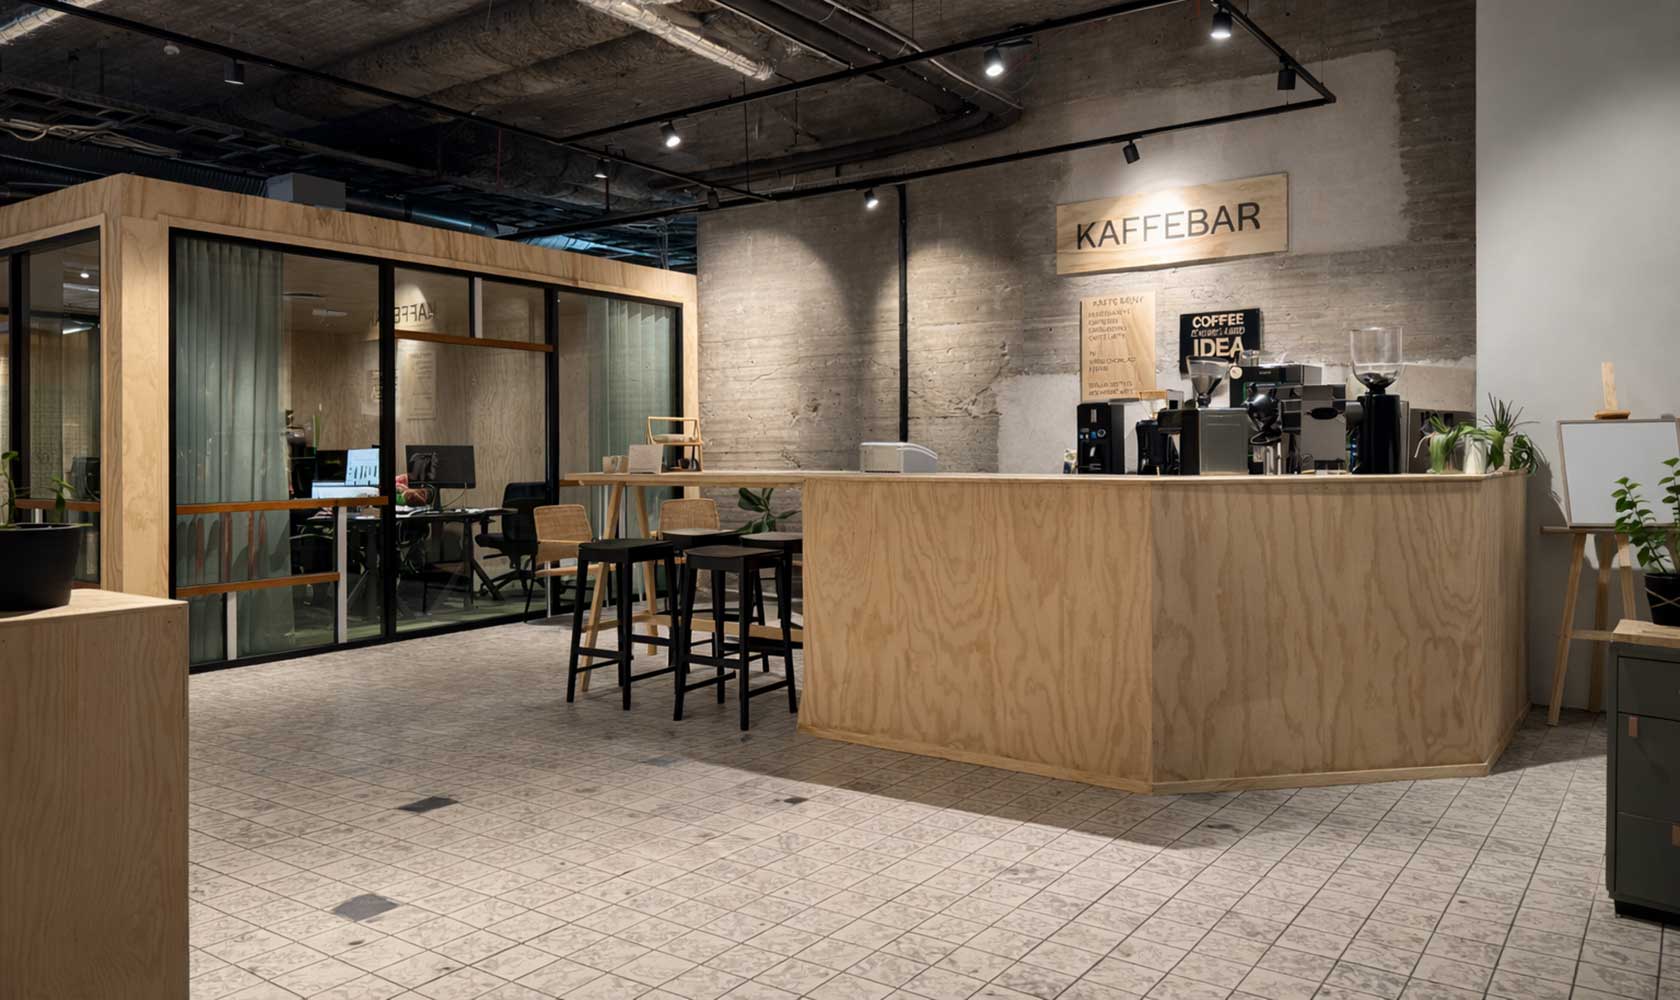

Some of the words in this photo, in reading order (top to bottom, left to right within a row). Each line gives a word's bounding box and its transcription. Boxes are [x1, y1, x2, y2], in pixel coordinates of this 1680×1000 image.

[1076, 201, 1261, 250] KAFFEBAR
[1192, 312, 1245, 329] COFFEE
[1193, 336, 1245, 358] IDEA
